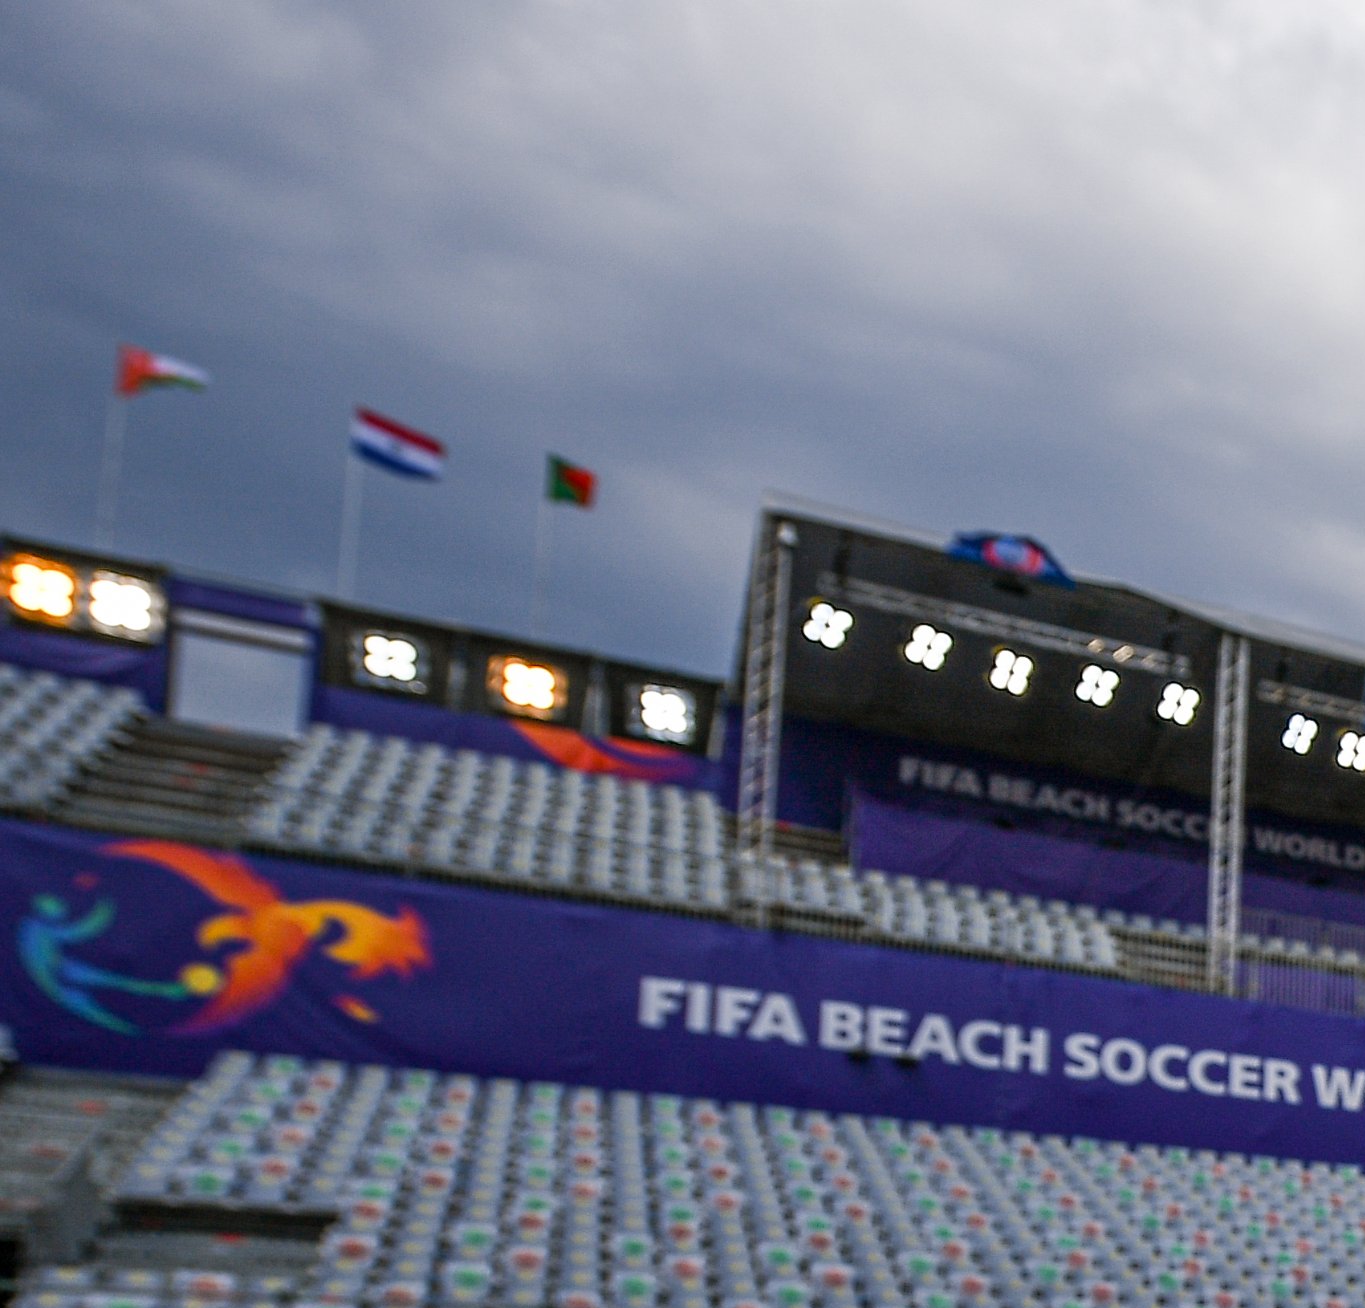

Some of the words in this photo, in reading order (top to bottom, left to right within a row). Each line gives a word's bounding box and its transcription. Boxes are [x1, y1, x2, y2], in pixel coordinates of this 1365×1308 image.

[899, 756, 982, 797] FIFA
[988, 773, 1109, 820] BEACH
[1116, 800, 1243, 842] SOCC
[638, 976, 805, 1045] FIFA
[819, 1000, 1049, 1074] BEACH
[1064, 1033, 1301, 1104] SOCCER
